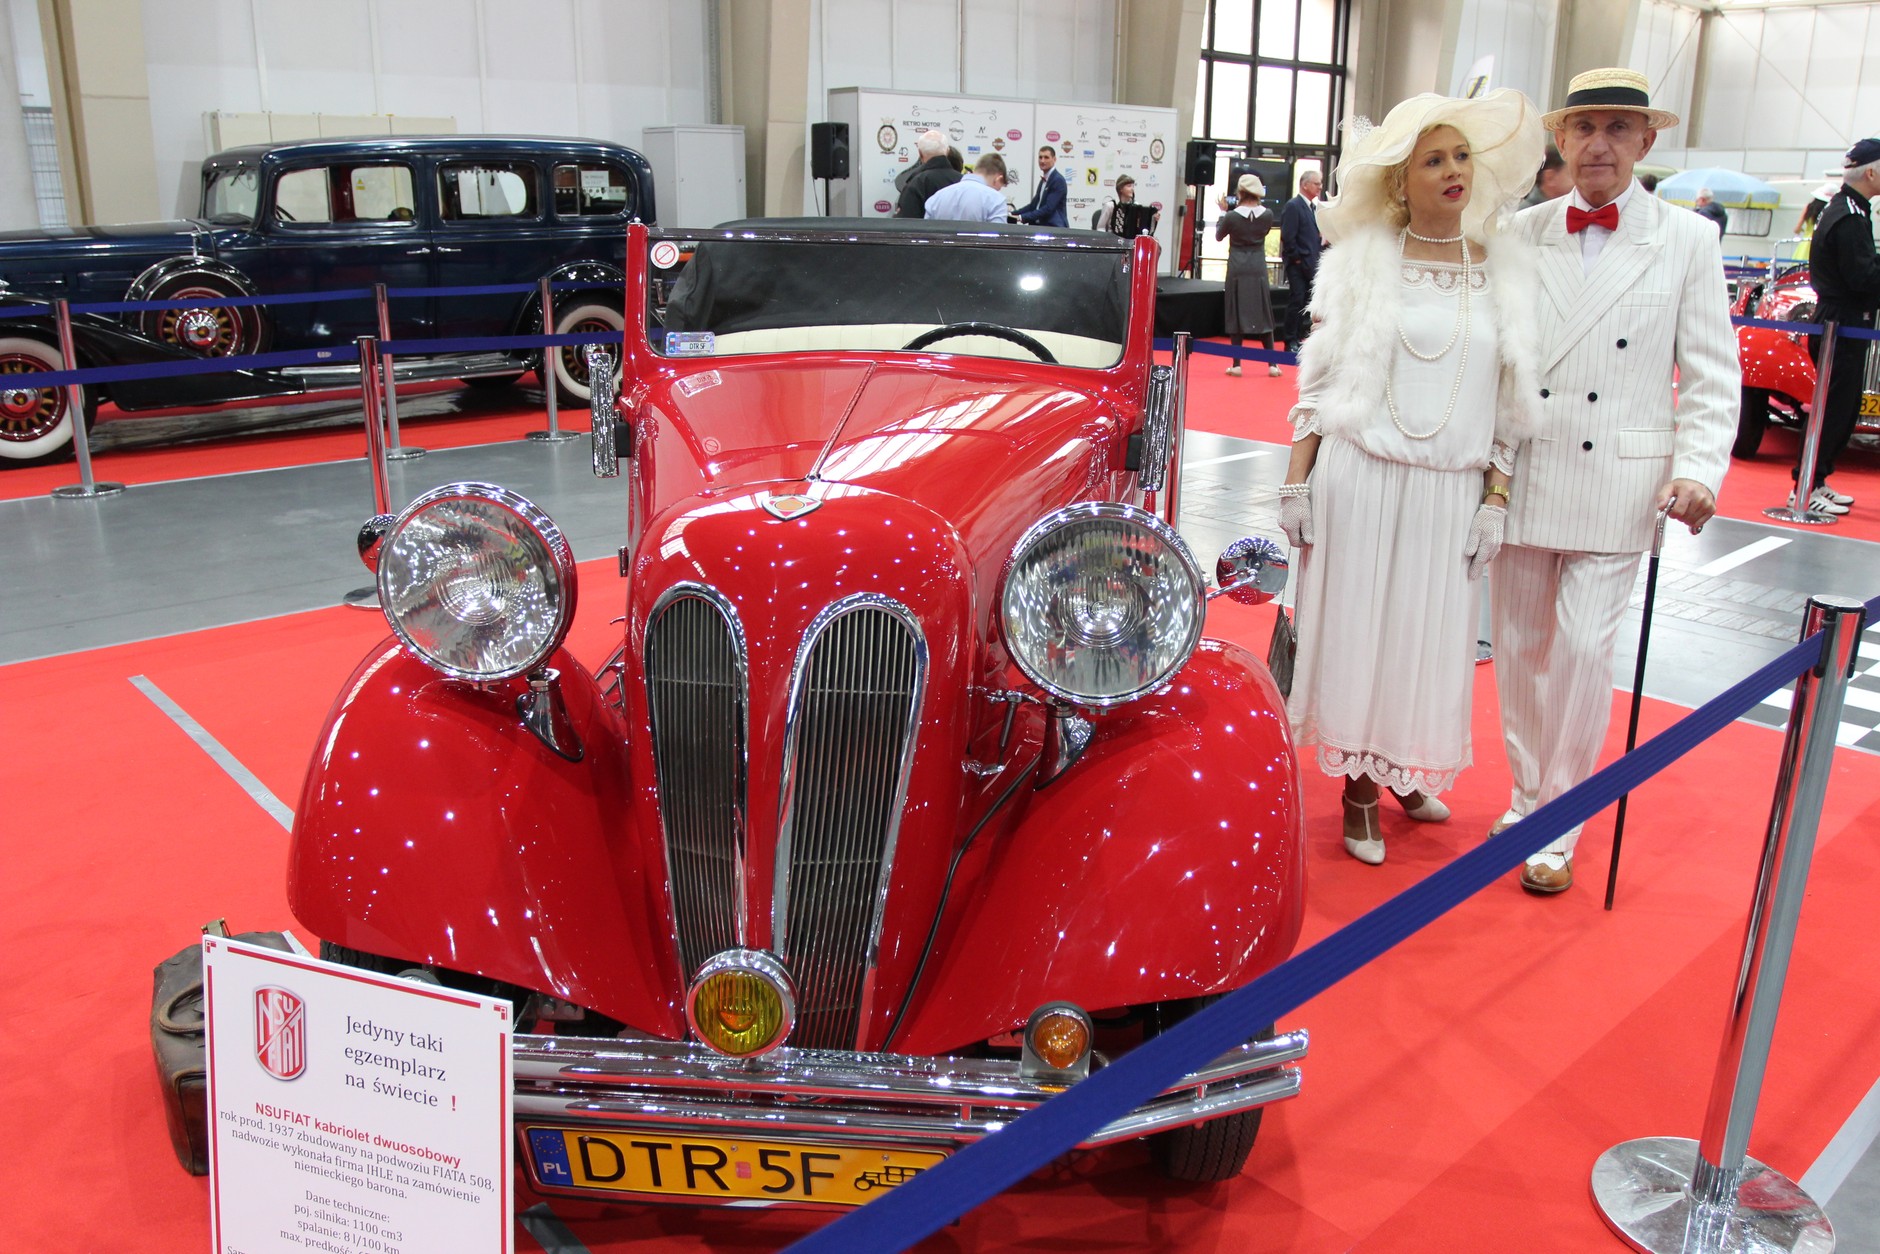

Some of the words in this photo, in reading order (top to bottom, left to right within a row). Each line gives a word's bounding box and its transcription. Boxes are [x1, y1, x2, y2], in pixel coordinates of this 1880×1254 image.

[346, 1015, 404, 1046] Jedyny
[410, 1031, 444, 1053] taki
[344, 1046, 446, 1082] egzemplarz
[345, 1074, 365, 1089] na
[373, 1076, 438, 1107] świecie
[220, 1110, 237, 1123] rok
[240, 1116, 266, 1130] prod.
[270, 1122, 294, 1138] 1937
[297, 1130, 358, 1157] zbudowany
[360, 1149, 373, 1160] na
[376, 1154, 430, 1175] podwoziu
[433, 1165, 466, 1184] FIATA
[470, 1174, 495, 1192] 508,
[314, 1118, 370, 1144] kabriolet
[374, 1134, 461, 1168] dwuosobowy
[232, 1129, 280, 1149] nadwozie
[282, 1142, 332, 1164] wykonała
[335, 1156, 364, 1172] firma
[367, 1164, 394, 1180] IHLE
[396, 1174, 410, 1185] na
[412, 1178, 480, 1204] zamówienie
[294, 1160, 364, 1188] niemieckiego
[366, 1178, 408, 1199] barona.
[542, 1162, 567, 1176] PL
[578, 1136, 730, 1191] DTR
[759, 1148, 841, 1196] 5F
[294, 1204, 312, 1217] poj.
[314, 1208, 350, 1227] silnika:
[353, 1219, 378, 1234] 1100
[381, 1229, 403, 1242] cm3
[306, 1190, 330, 1206] Dane
[333, 1198, 390, 1222] techniczne:
[280, 1230, 302, 1243] max.
[298, 1220, 341, 1240] spalanie:
[344, 1231, 350, 1242] 8
[384, 1242, 400, 1254] km
